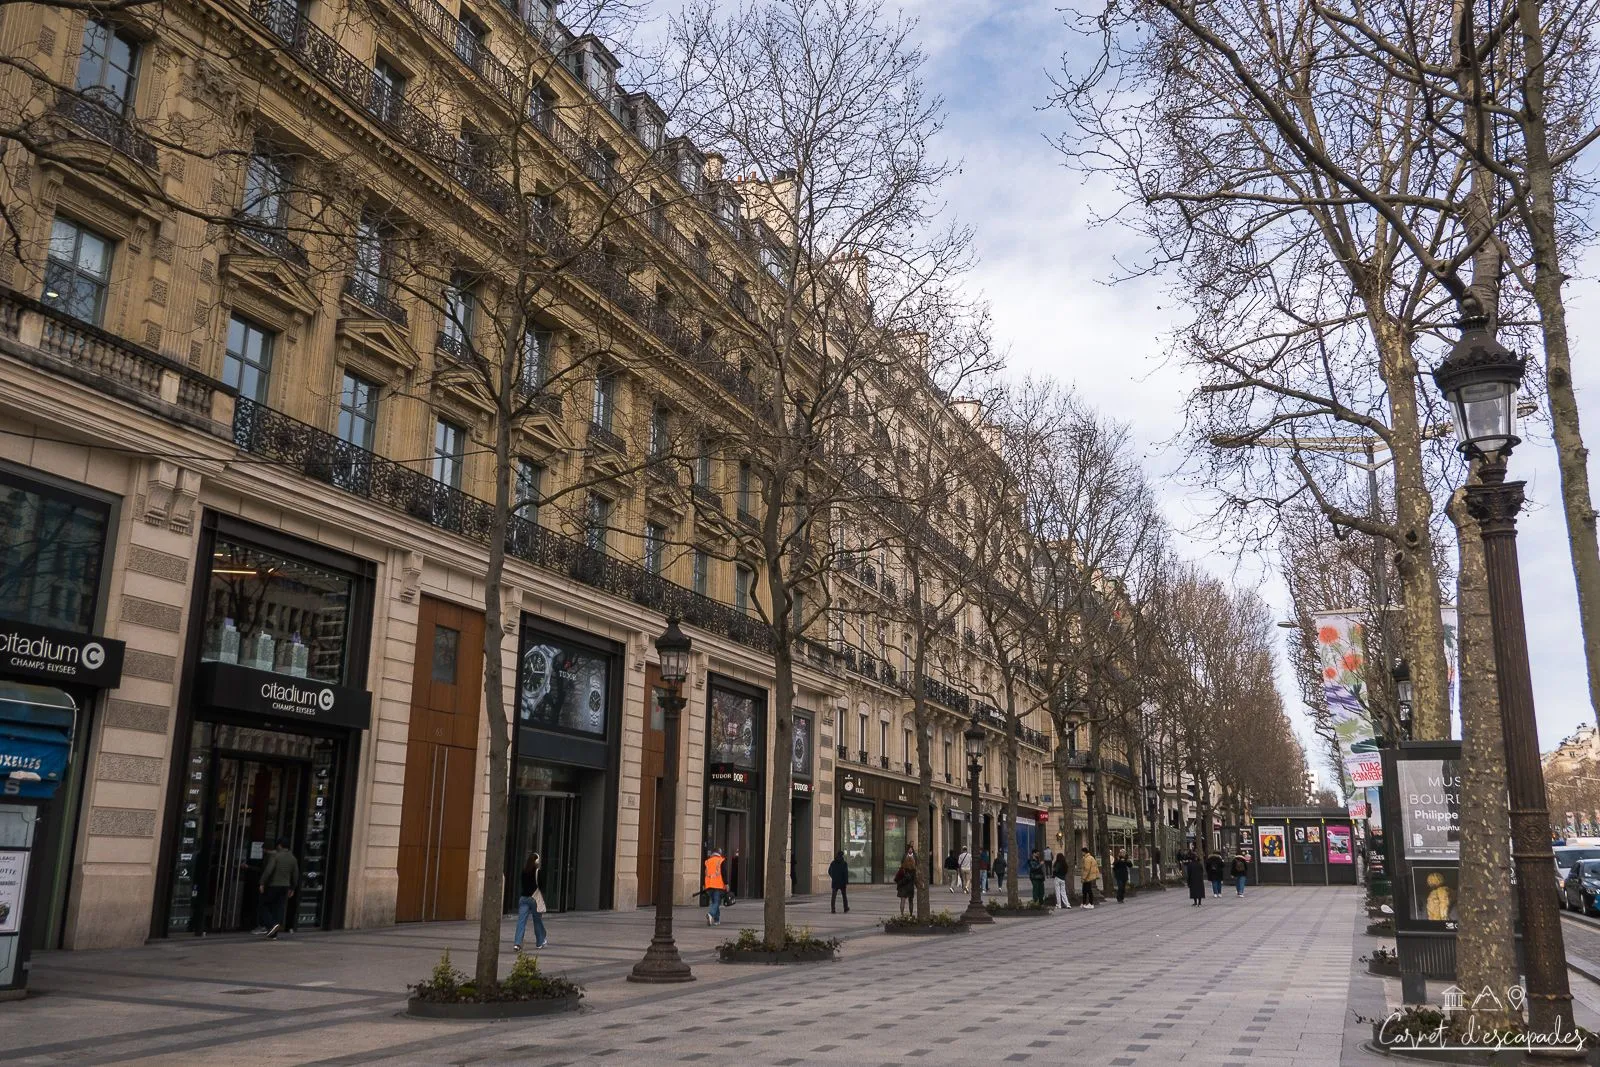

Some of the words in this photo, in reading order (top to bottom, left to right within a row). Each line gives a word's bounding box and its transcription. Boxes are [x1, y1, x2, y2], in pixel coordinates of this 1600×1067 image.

[0, 632, 78, 663] citadium
[11, 657, 45, 670] CHAMPS
[47, 663, 76, 675] ELYSEES
[261, 682, 316, 706] citadium
[272, 702, 295, 712] CHAMPS
[296, 706, 316, 715] ELYSEES
[733, 773, 743, 782] DOR
[794, 782, 808, 792] TUDOR
[1414, 810, 1459, 821] Philippe
